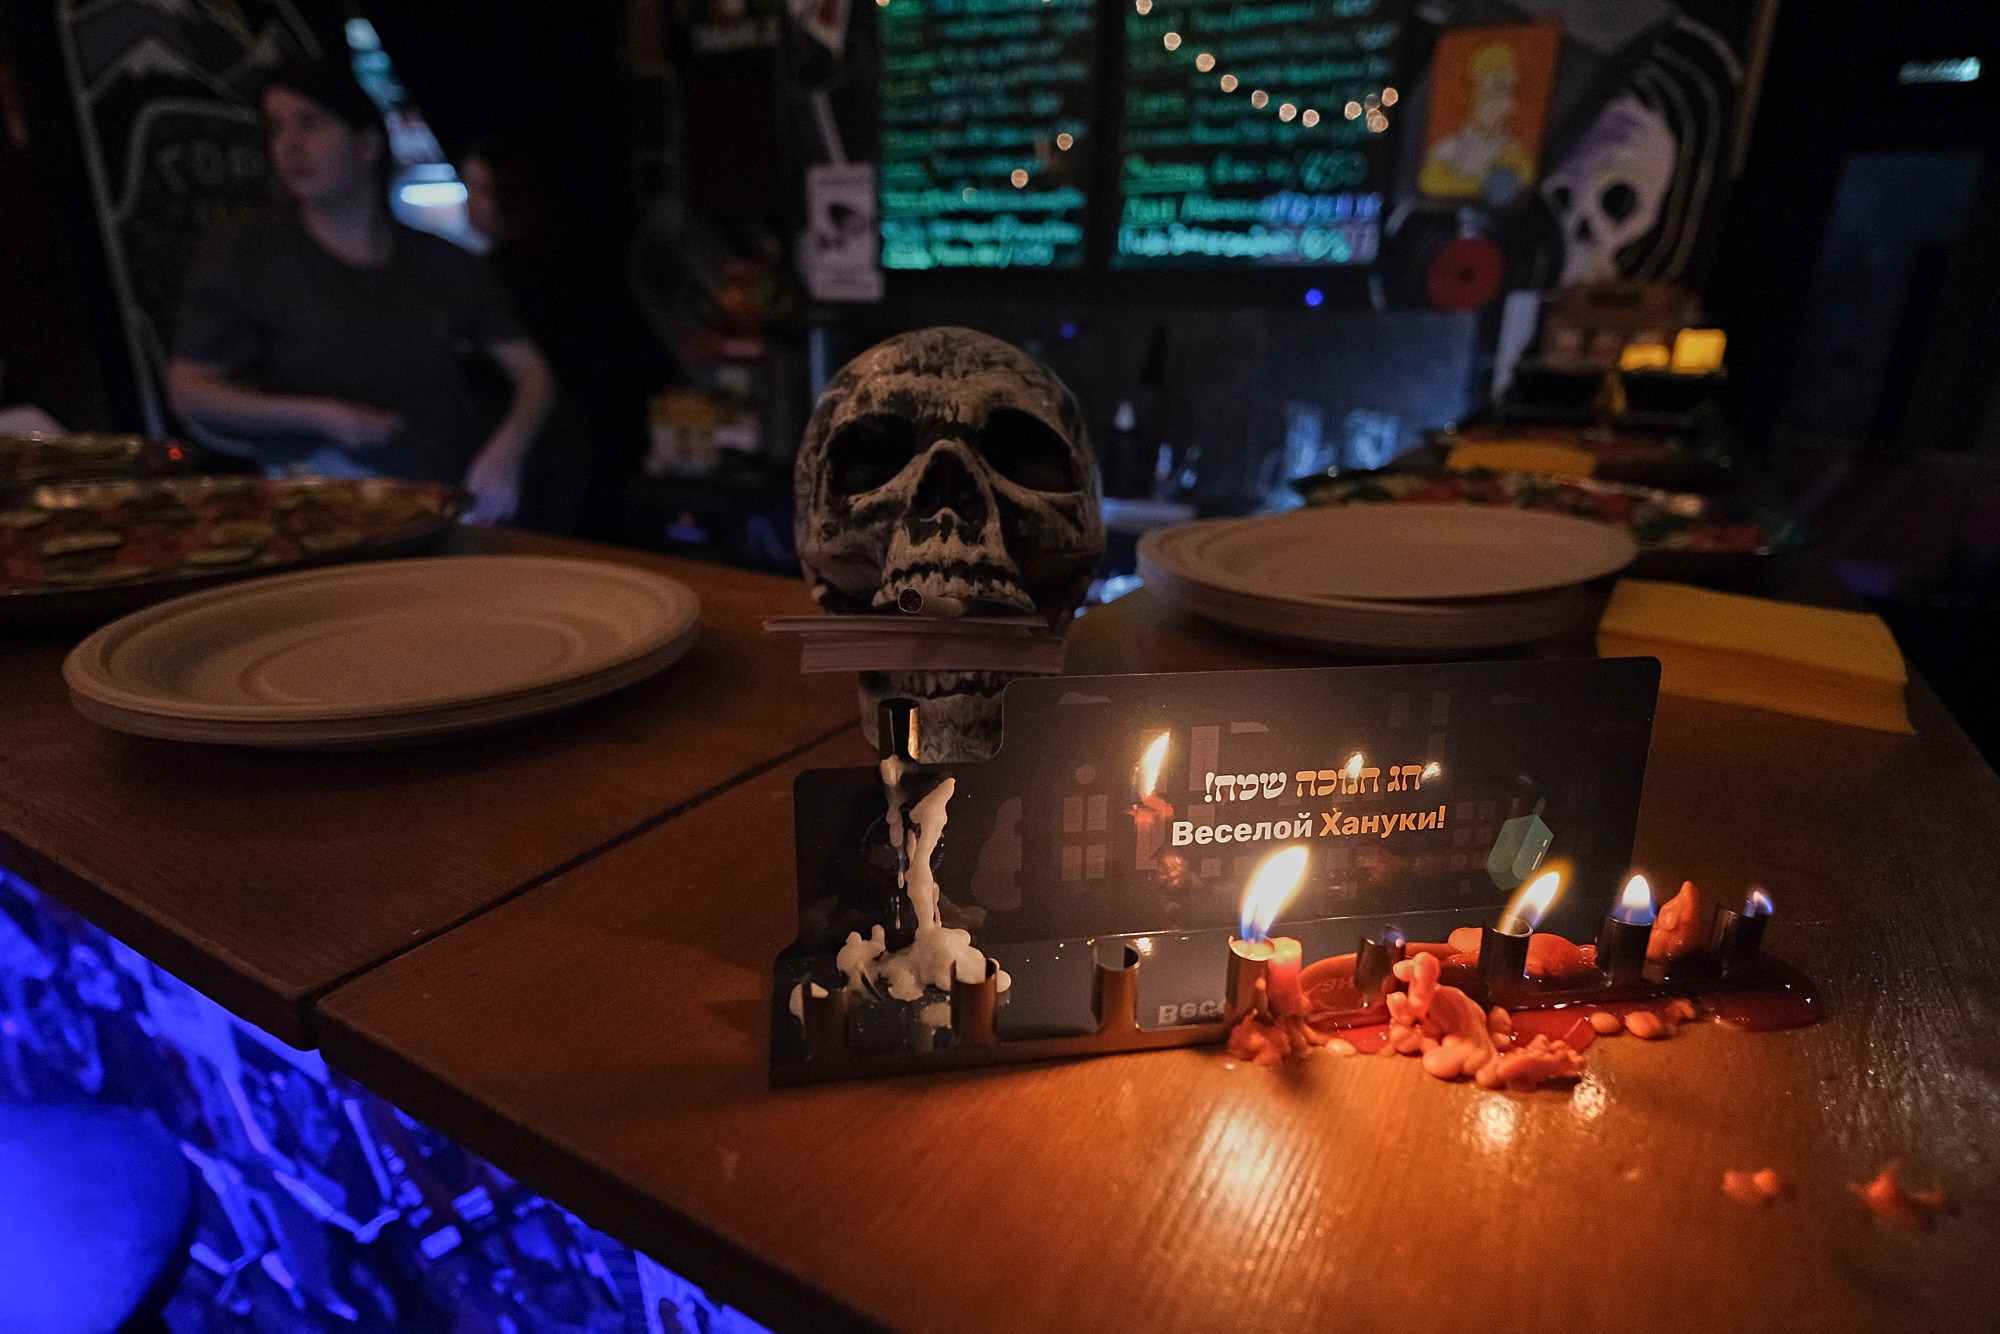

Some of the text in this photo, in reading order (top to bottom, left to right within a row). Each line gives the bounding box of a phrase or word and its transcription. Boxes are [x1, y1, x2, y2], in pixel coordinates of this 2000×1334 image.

[1204, 771, 1287, 803] שמח!
[1386, 764, 1421, 793] חג
[1171, 804, 1447, 847] Веселой Хануки!
